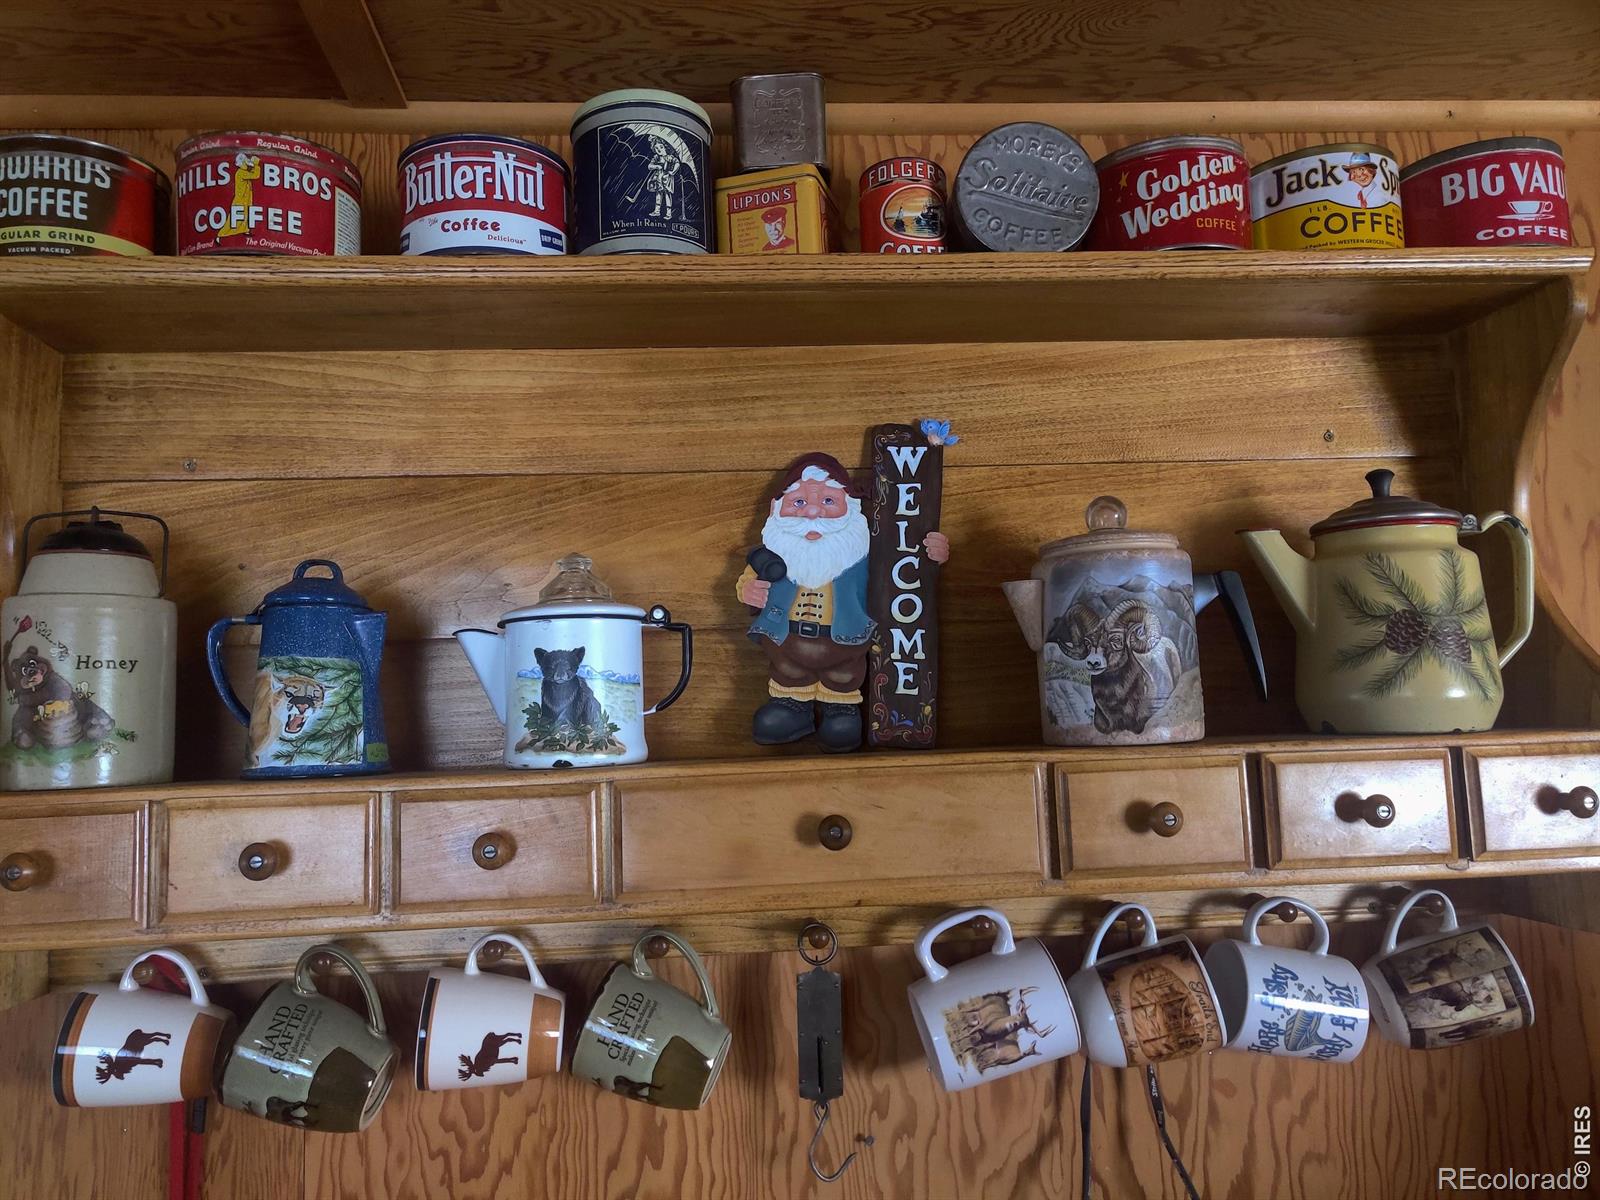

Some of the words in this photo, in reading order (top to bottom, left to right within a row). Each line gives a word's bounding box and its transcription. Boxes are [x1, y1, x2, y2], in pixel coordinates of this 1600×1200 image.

[256, 138, 291, 152] Regular
[293, 144, 318, 160] Grind
[0, 155, 111, 189] WARDS
[178, 161, 231, 198] HILLS
[264, 163, 332, 201] BROS
[405, 150, 545, 214] Butter-Nut
[965, 157, 1089, 216] Solitaire
[1136, 155, 1236, 200] Golden
[1266, 158, 1343, 208] Jack
[1441, 163, 1505, 207] BIG
[733, 188, 791, 210] LIPTON'S
[1120, 181, 1244, 240] Wedding
[194, 205, 302, 235] COFFEE
[440, 217, 501, 232] Coffee
[612, 219, 635, 229] When
[637, 217, 643, 227] It
[644, 218, 667, 228] Rains
[679, 225, 698, 238] POURS
[973, 208, 1062, 245] COFFEE
[1196, 217, 1237, 231] COFFEE
[1300, 211, 1404, 241] COFFEE
[1475, 225, 1568, 241] COFFEE
[40, 246, 71, 254] PACKED
[48, 230, 96, 244] GRIND
[245, 238, 258, 246] The
[259, 239, 287, 250] Original
[288, 242, 313, 255] Vacuum
[886, 446, 928, 695] WELCOME
[75, 655, 139, 673] Honey
[260, 1005, 291, 1055] HAND
